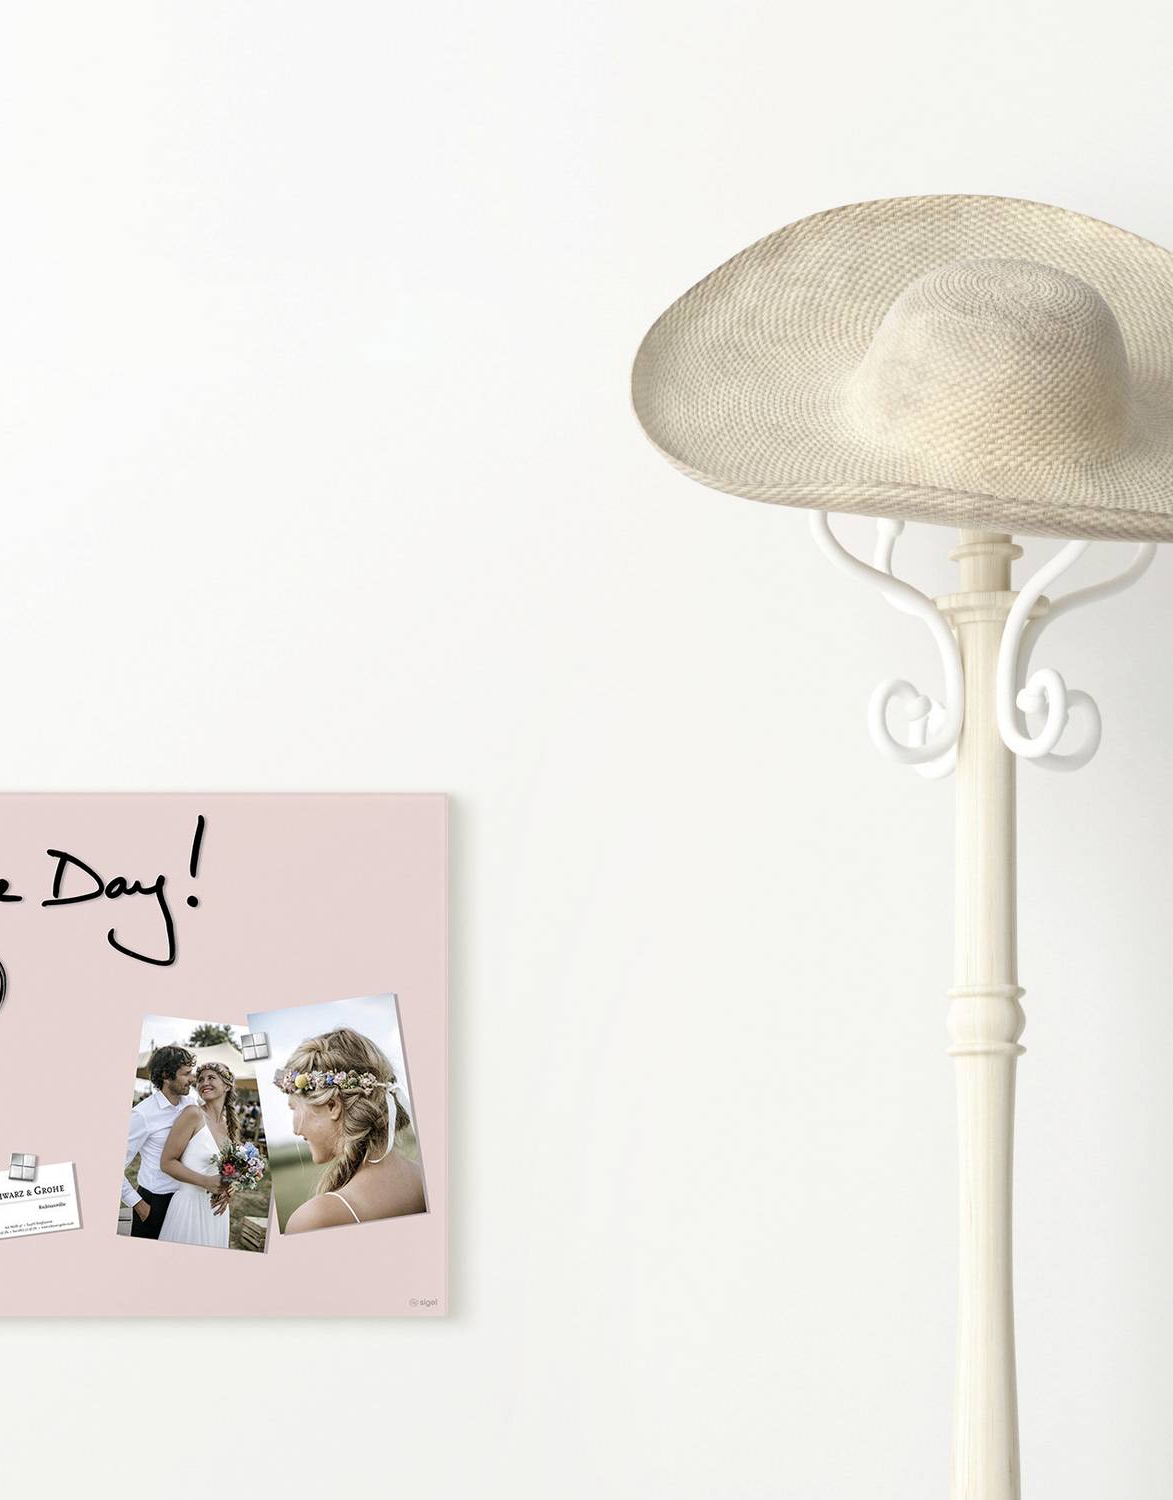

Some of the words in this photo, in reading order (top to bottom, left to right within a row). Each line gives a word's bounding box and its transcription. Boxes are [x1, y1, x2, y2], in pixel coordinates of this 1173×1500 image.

[41, 814, 206, 967] Day!
[26, 1189, 32, 1197] &
[33, 1184, 65, 1195] GROHE
